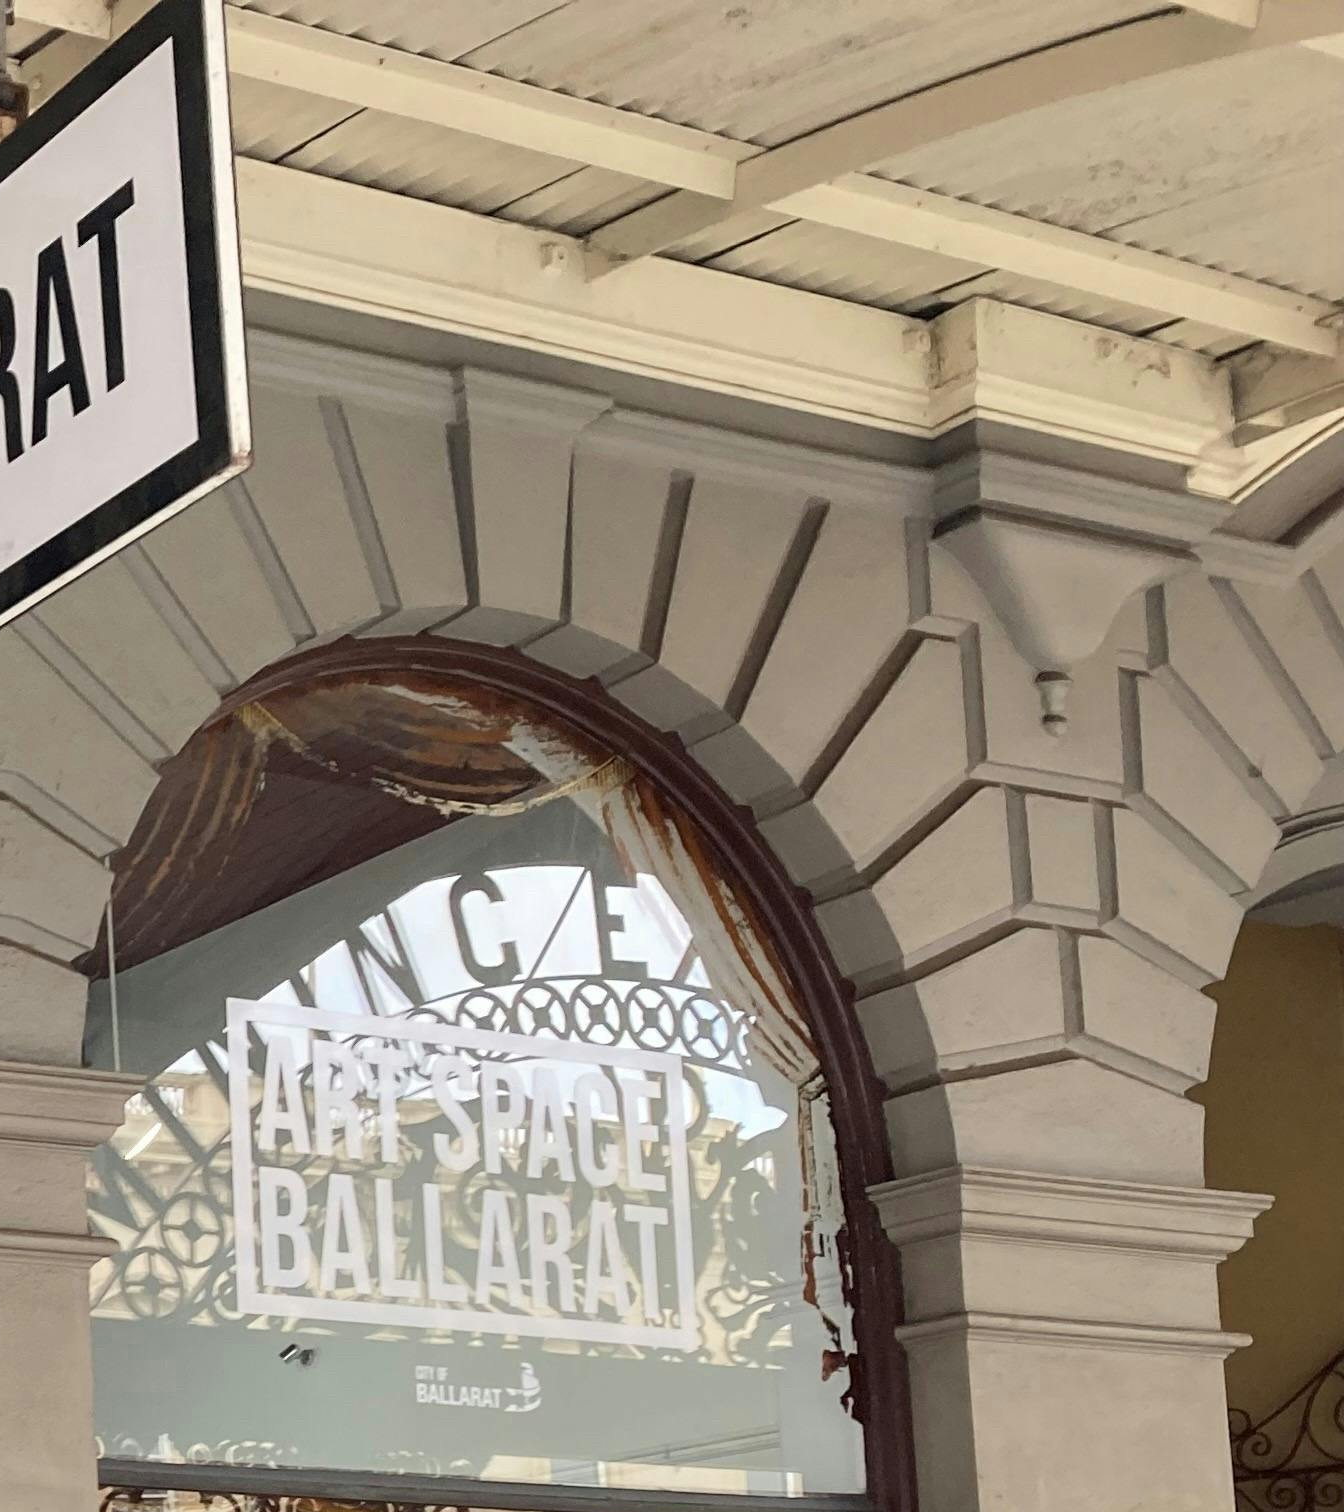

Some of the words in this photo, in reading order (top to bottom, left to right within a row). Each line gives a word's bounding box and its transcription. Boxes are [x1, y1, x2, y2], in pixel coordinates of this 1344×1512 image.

[257, 1034, 408, 1165] ART
[431, 1054, 668, 1193] SPACE
[257, 1165, 670, 1321] BALLARAT
[415, 1383, 502, 1409] BALLARAT
